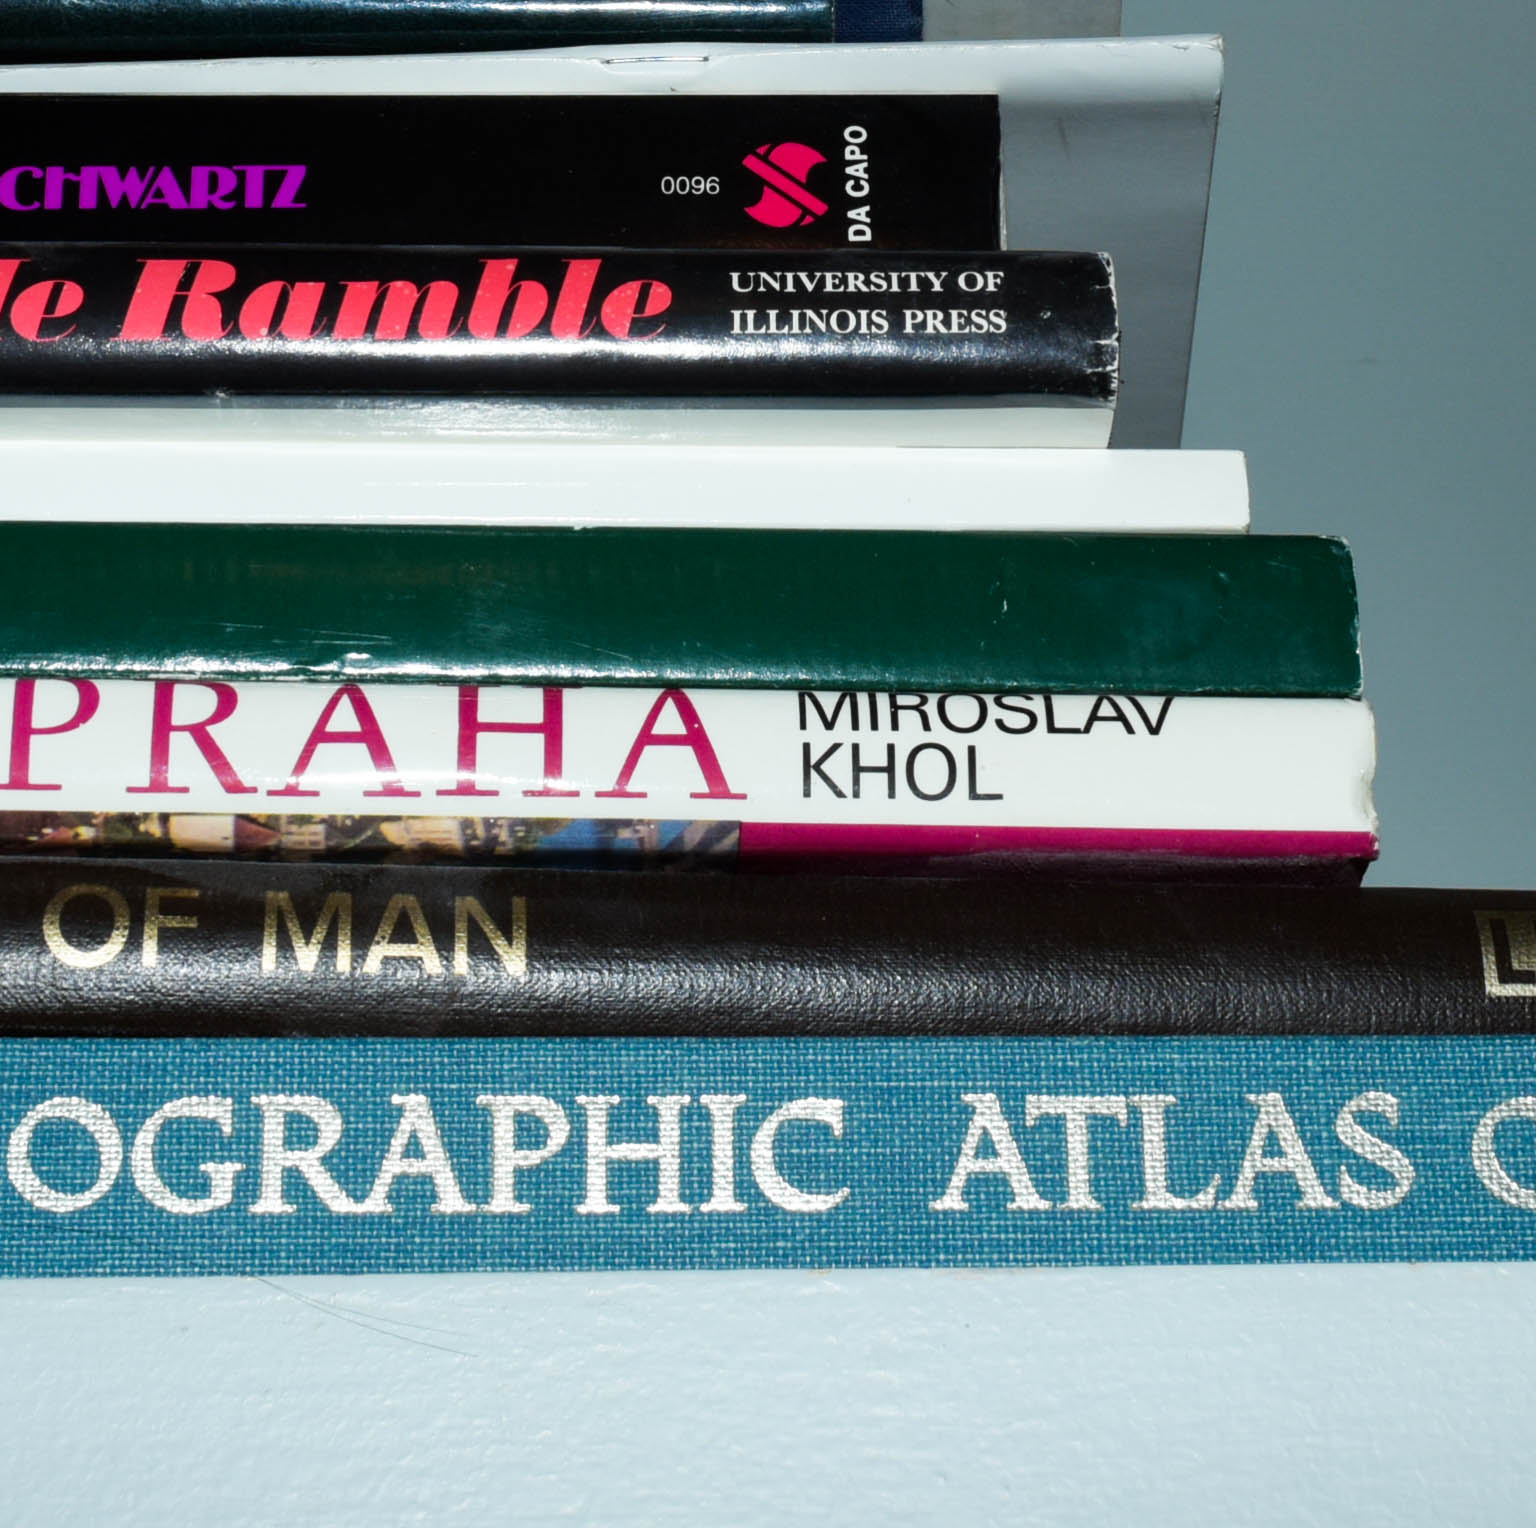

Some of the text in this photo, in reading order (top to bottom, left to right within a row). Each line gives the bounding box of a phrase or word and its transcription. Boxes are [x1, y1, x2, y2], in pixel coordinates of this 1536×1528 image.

[660, 176, 720, 195] 0096
[843, 125, 872, 242] DA CAPO
[109, 258, 672, 342] Ramble
[730, 271, 1004, 293] UNIVERSITY OF
[730, 309, 1008, 335] ILLINOIS PRESS
[796, 691, 1176, 737] MIROSLAV
[800, 741, 1004, 803] KHOL
[42, 883, 200, 970] OF
[260, 890, 527, 977] MAN
[928, 1089, 1416, 1211] ATLAS
